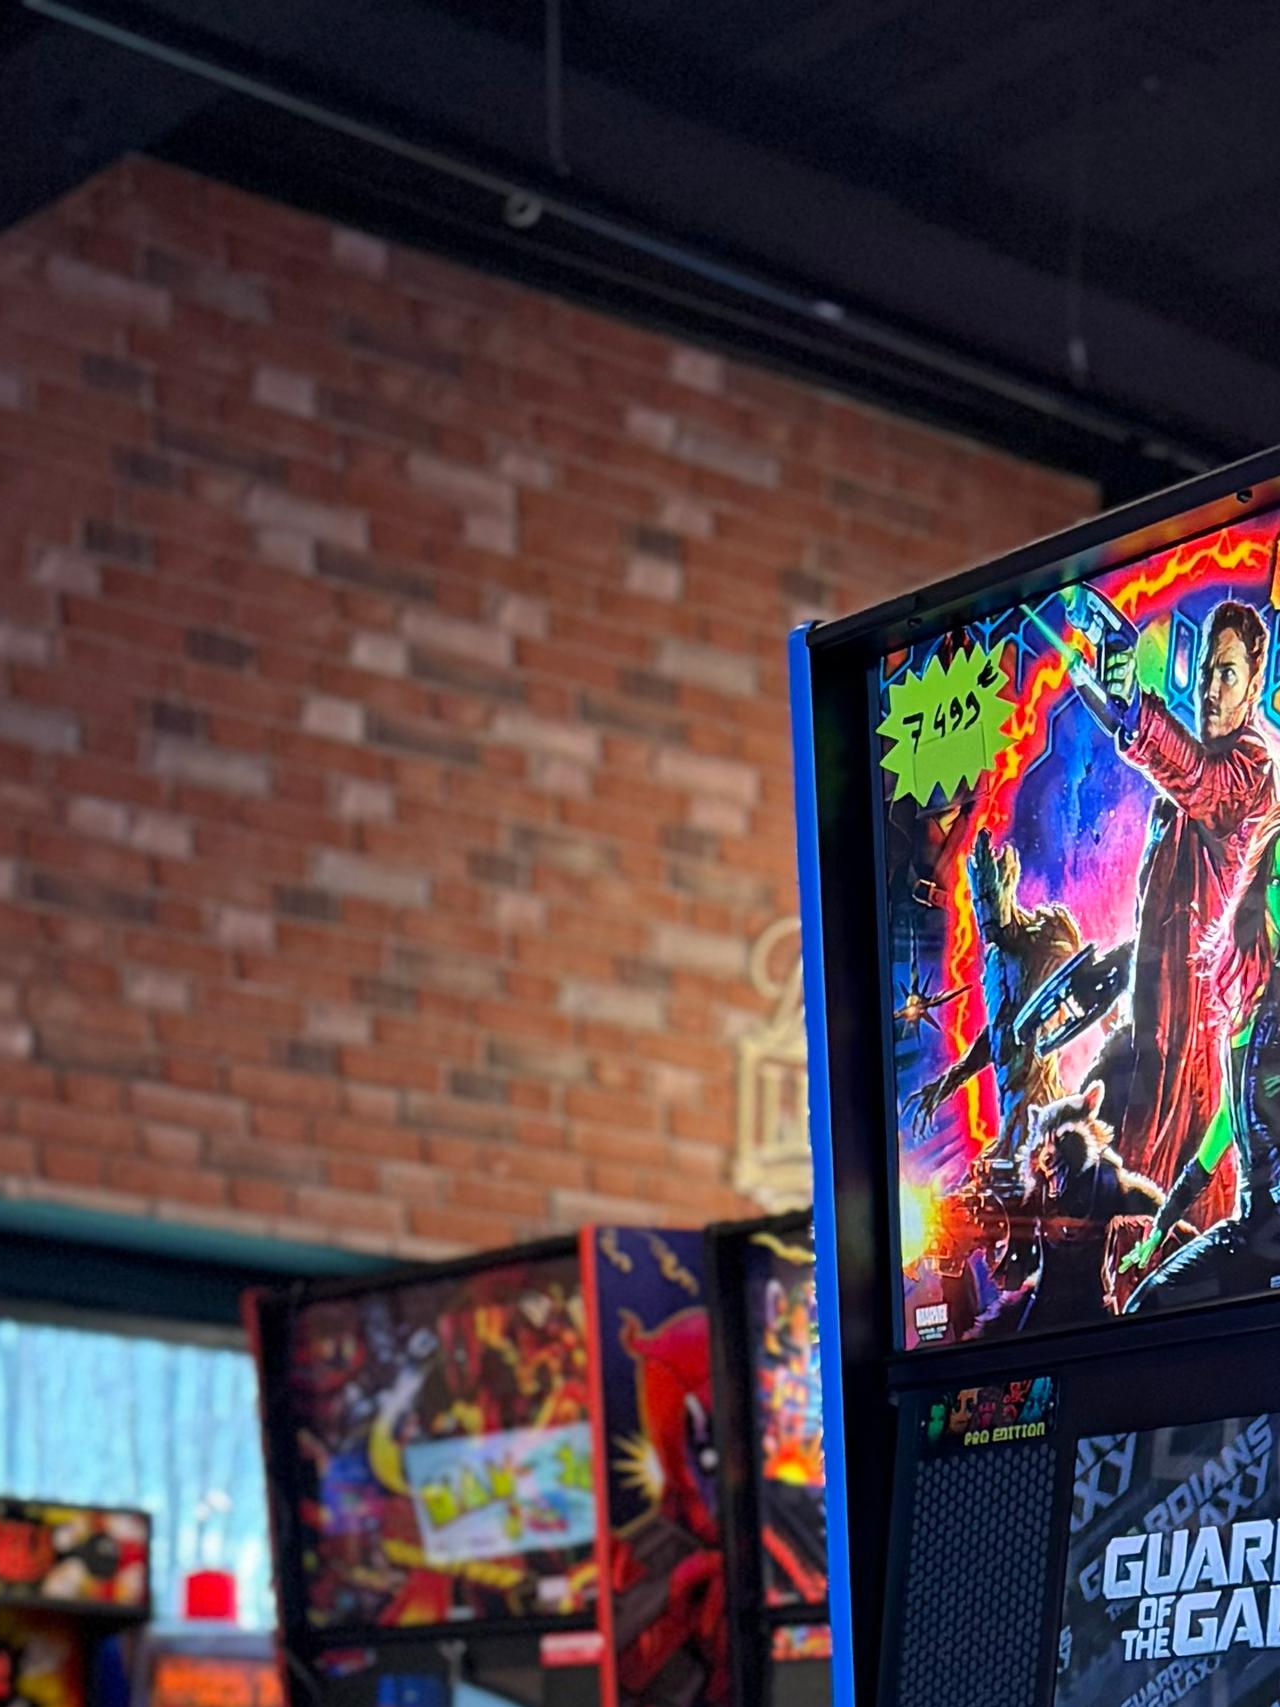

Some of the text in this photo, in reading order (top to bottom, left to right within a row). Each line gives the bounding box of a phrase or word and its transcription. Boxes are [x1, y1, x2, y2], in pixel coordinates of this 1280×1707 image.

[964, 1421, 1046, 1447] PRO EDITION
[1139, 1596, 1176, 1629] OF
[1122, 1629, 1171, 1662] THE
